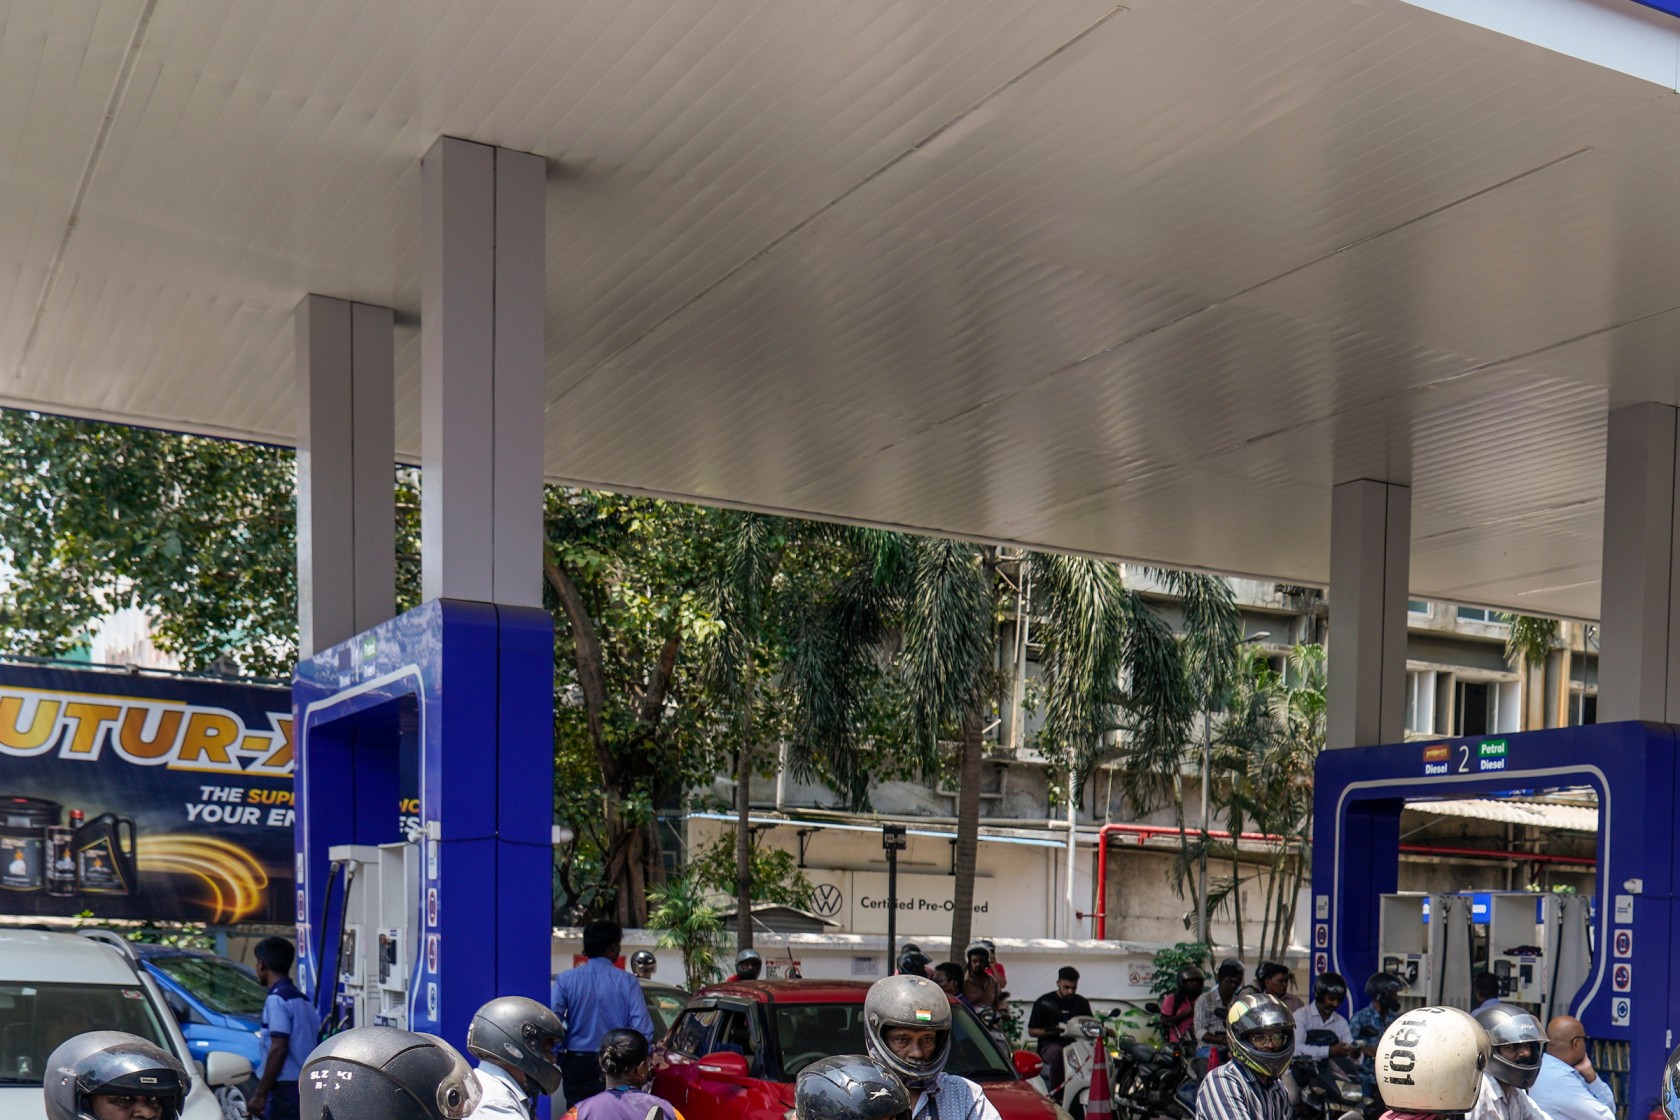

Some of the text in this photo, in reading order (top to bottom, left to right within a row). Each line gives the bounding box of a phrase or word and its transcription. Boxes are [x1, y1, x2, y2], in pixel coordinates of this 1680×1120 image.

[1480, 742, 1505, 755] Petrol
[1457, 745, 1470, 773] 2
[1480, 758, 1505, 770] Diesel
[1424, 763, 1448, 774] Diesel
[200, 785, 245, 803] THE
[185, 803, 261, 825] YOUR
[918, 899, 988, 913] Pre-Oed
